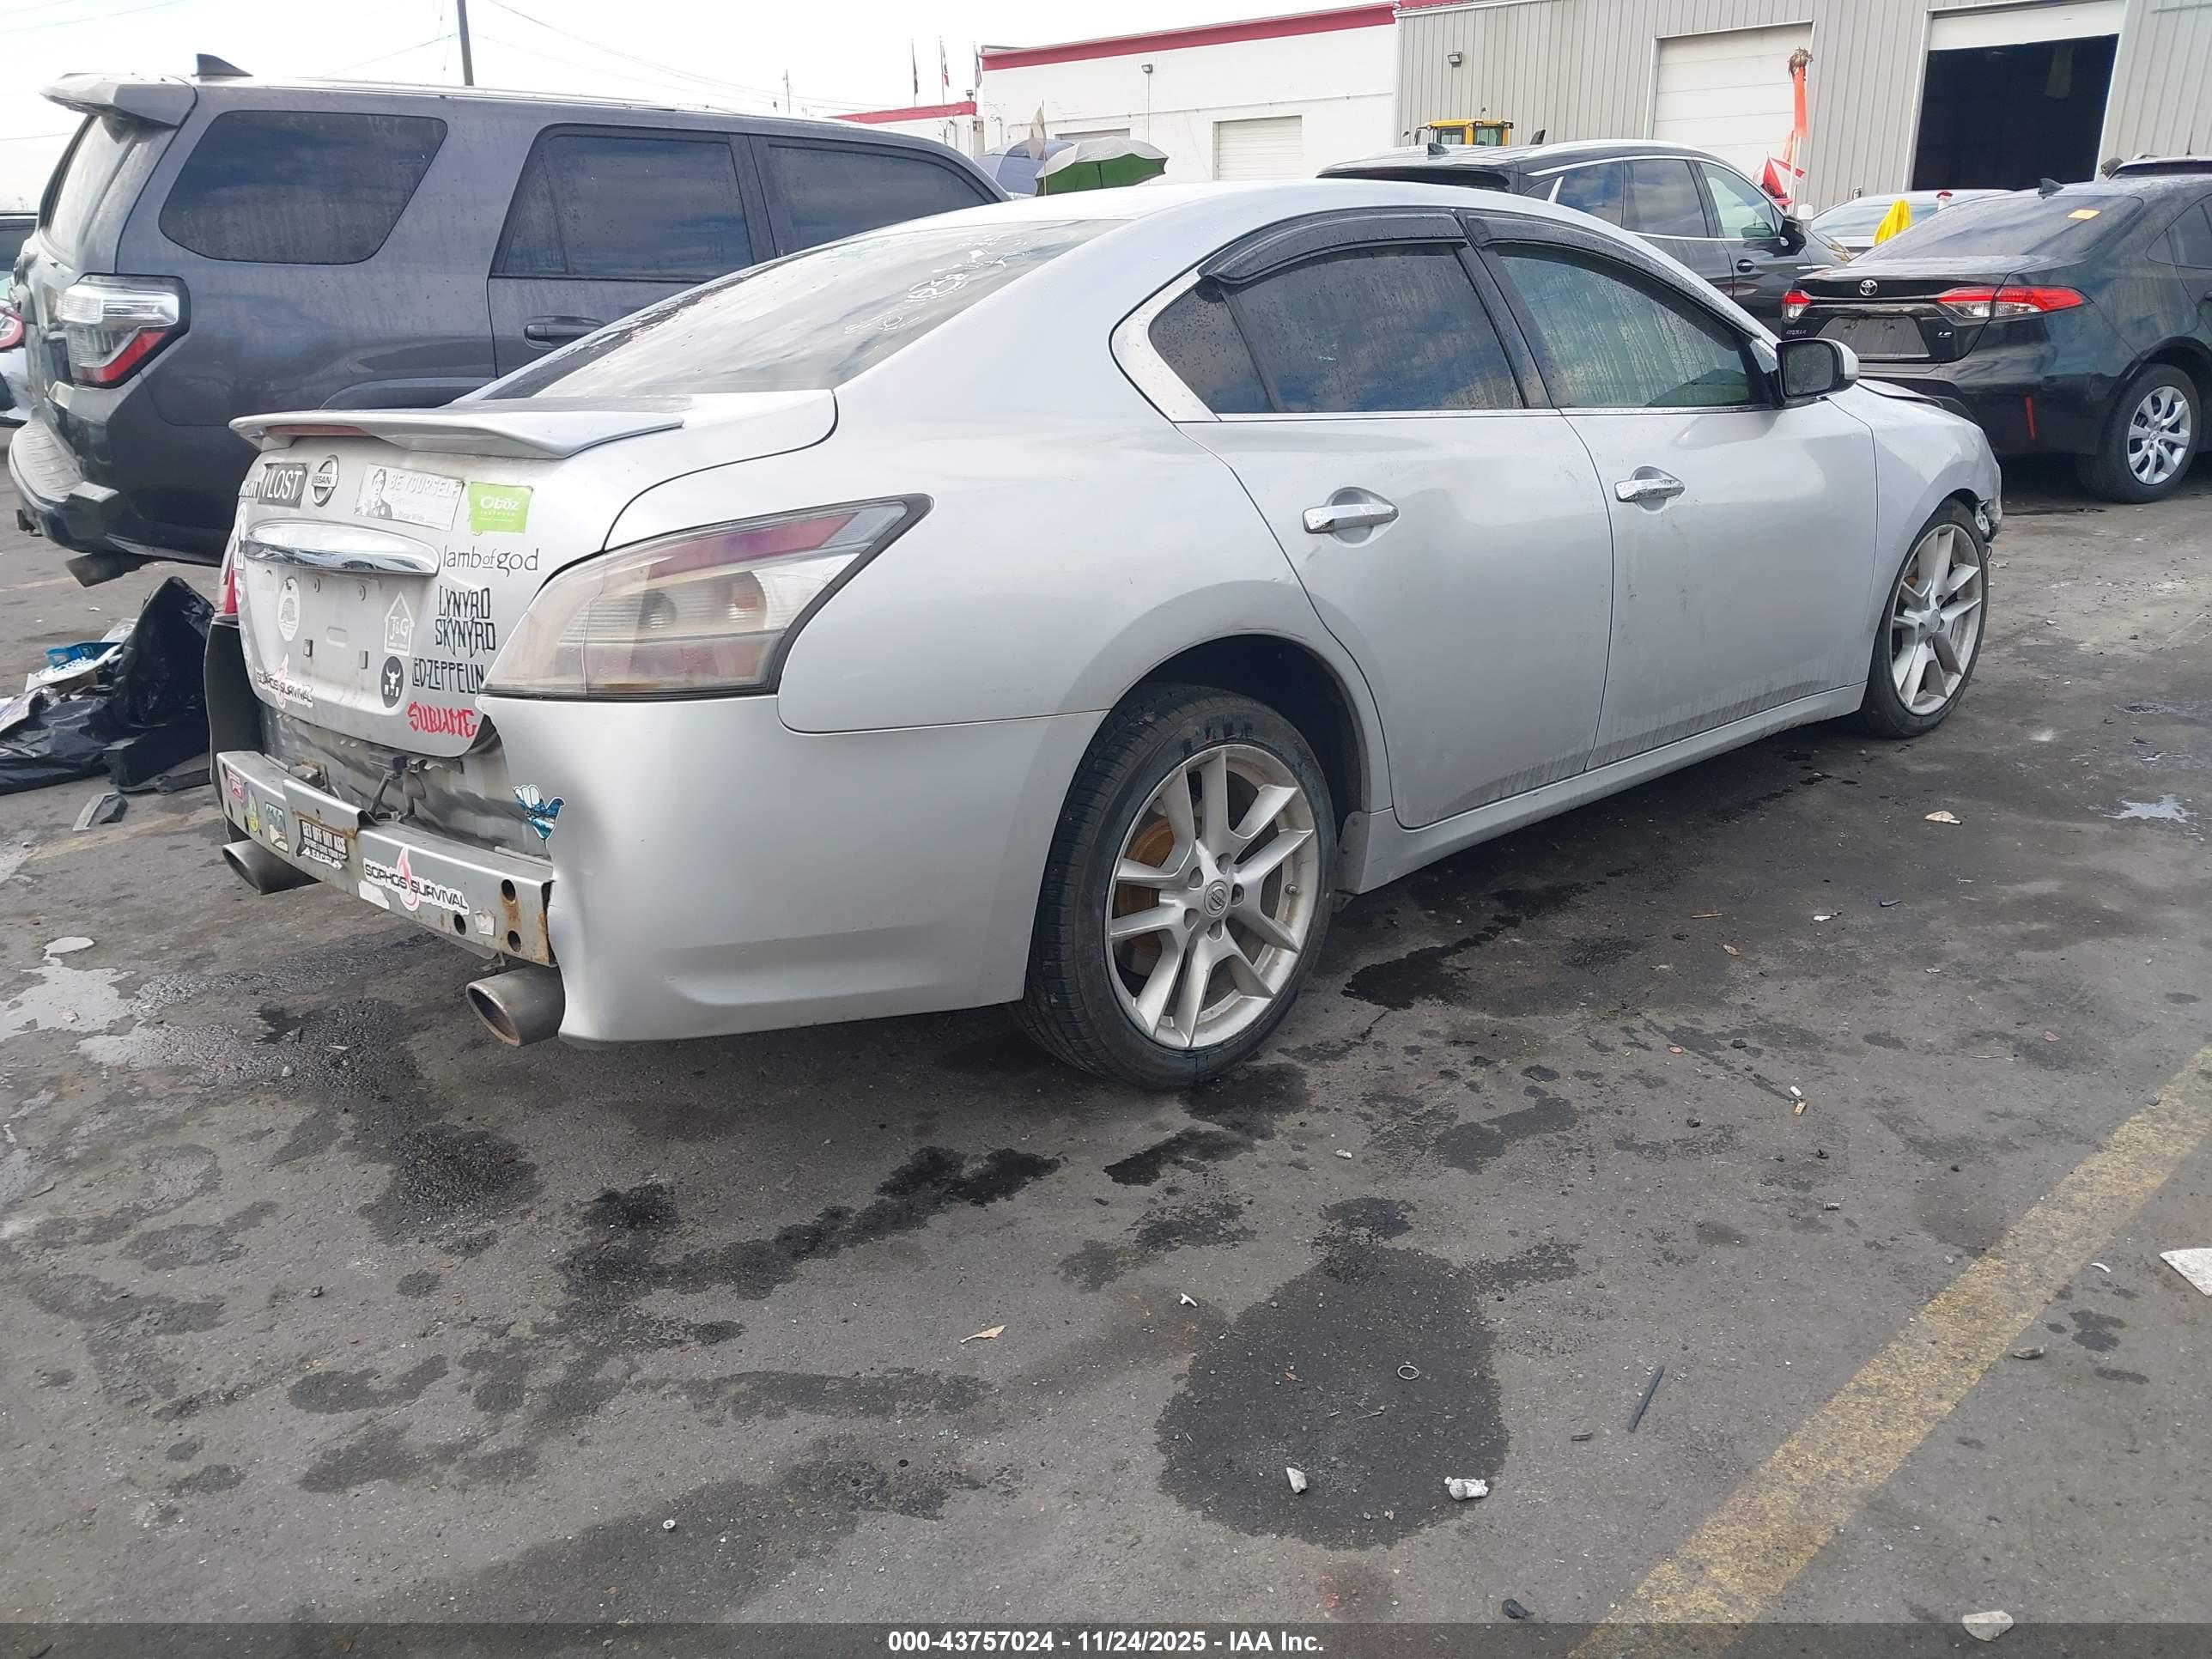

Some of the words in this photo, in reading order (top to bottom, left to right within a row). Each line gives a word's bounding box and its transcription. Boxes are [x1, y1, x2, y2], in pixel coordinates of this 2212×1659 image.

[389, 474, 404, 490] BE
[439, 584, 490, 619] LYNYRD
[435, 617, 495, 658] SKYNYRD
[407, 701, 477, 738] SUBLIME
[365, 864, 408, 889] SOPHOS
[410, 880, 468, 910] SURVIVAL
